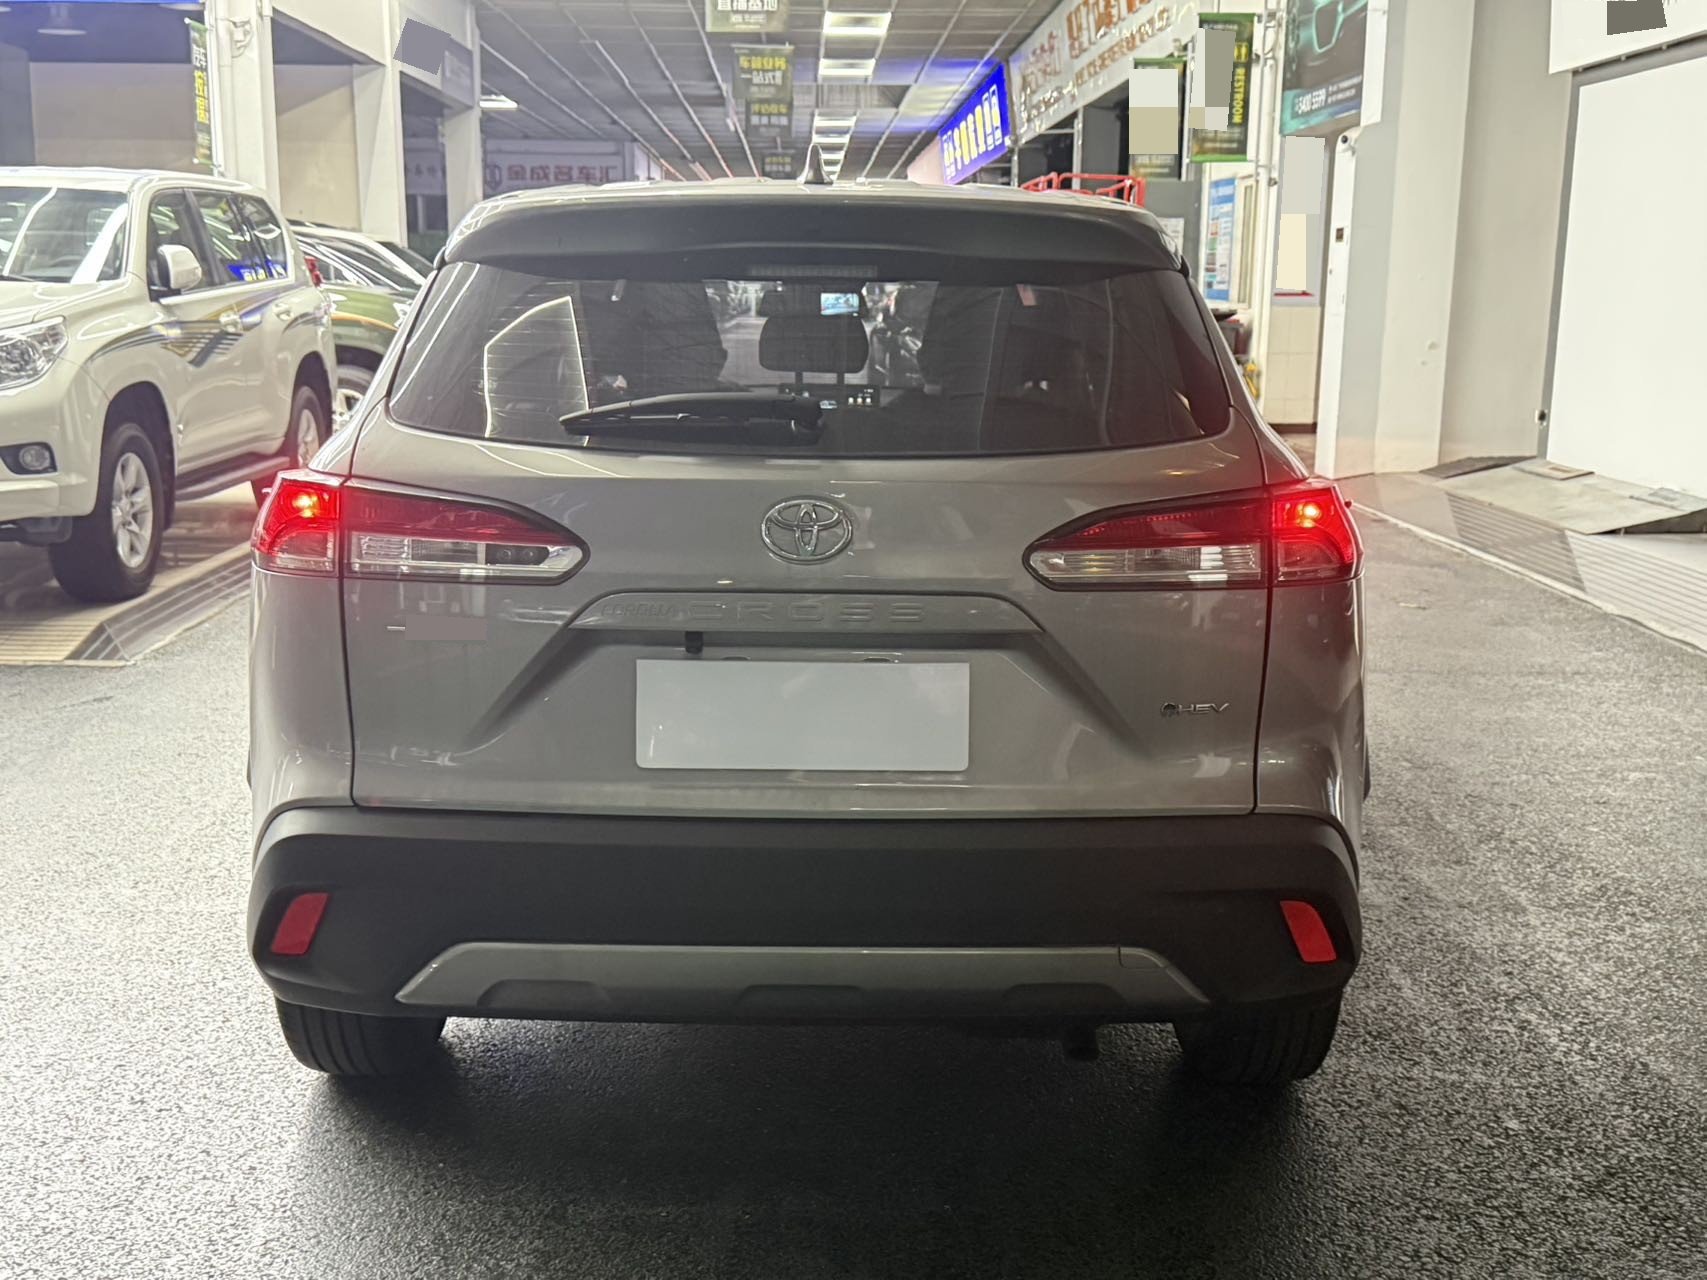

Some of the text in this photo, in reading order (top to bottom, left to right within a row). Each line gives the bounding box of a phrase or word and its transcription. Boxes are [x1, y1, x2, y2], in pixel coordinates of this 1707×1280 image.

[1232, 67, 1246, 124] RESTROOM
[689, 600, 926, 623] CROSS
[1179, 702, 1230, 715] HEV
